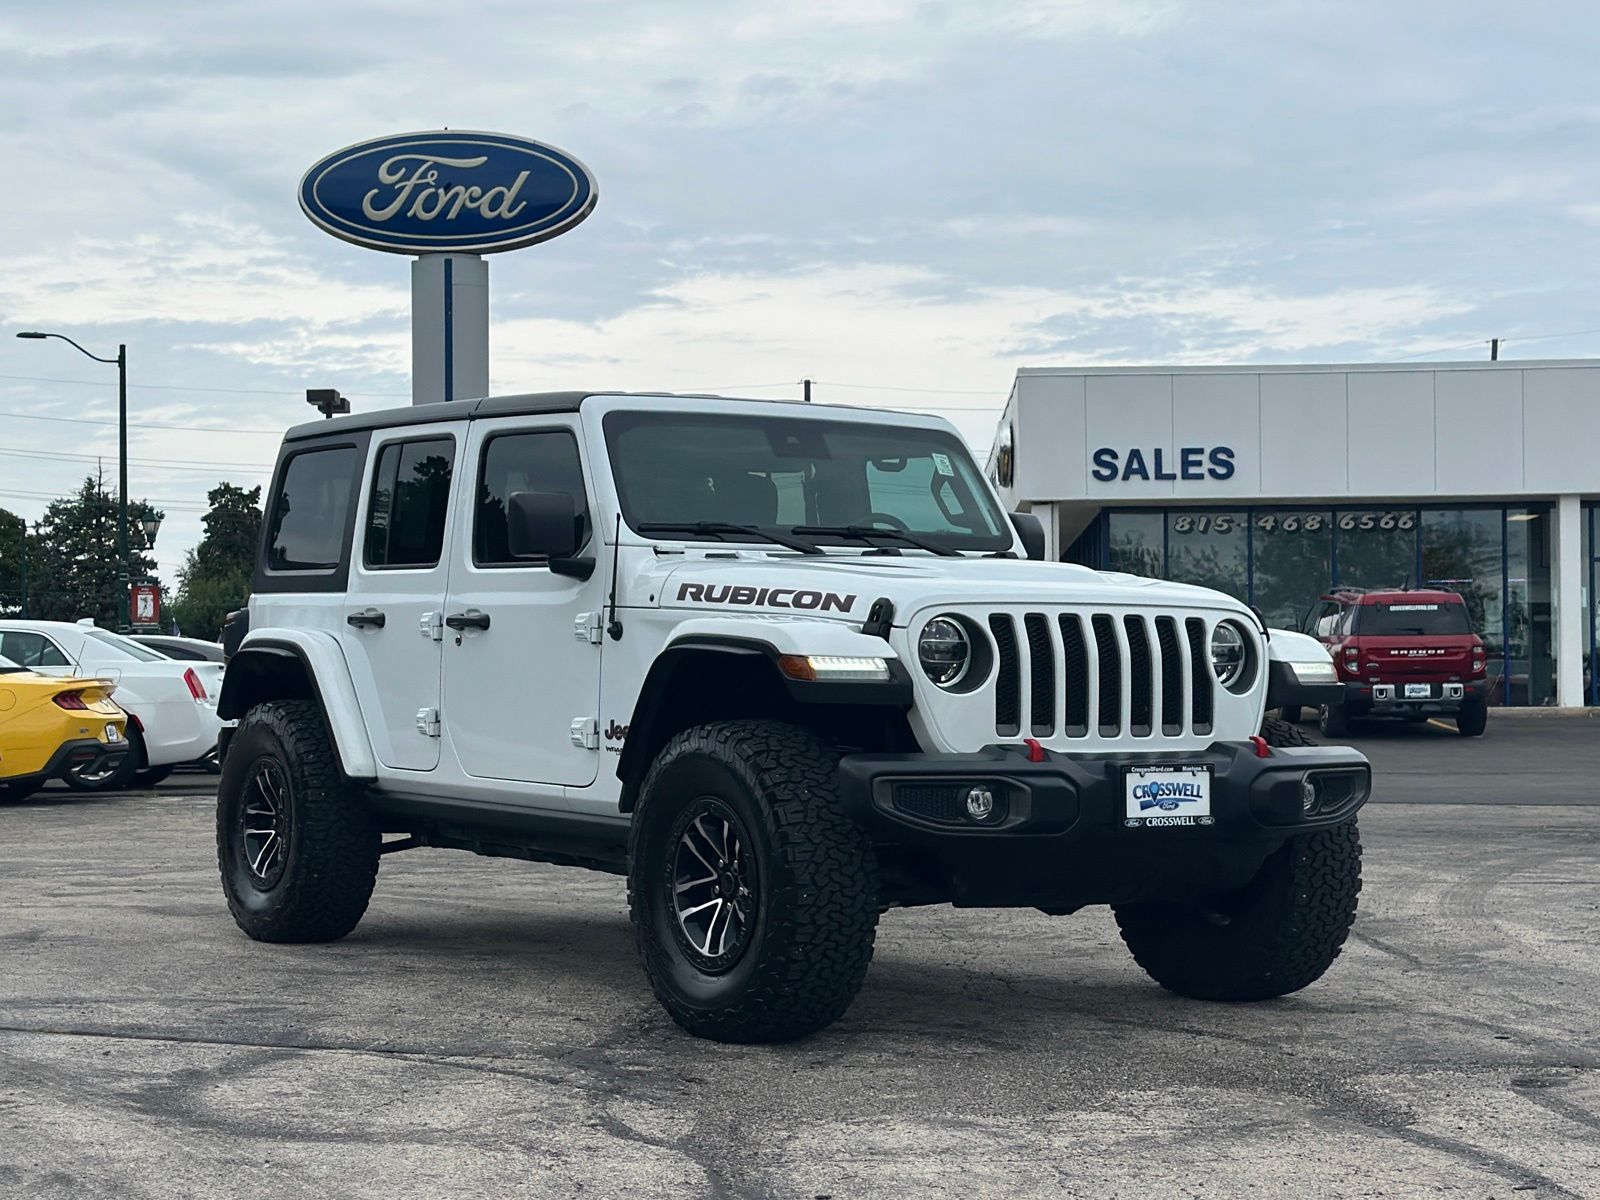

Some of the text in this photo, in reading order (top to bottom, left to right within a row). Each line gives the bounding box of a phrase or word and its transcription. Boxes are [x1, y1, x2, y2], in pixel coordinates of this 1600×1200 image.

[362, 154, 531, 221] Ford
[1091, 446, 1235, 482] SALES
[676, 582, 857, 613] RUBICON
[605, 719, 630, 740] Jee
[1132, 782, 1203, 800] CROSSWELL
[1146, 816, 1196, 827] CROSSWELL
